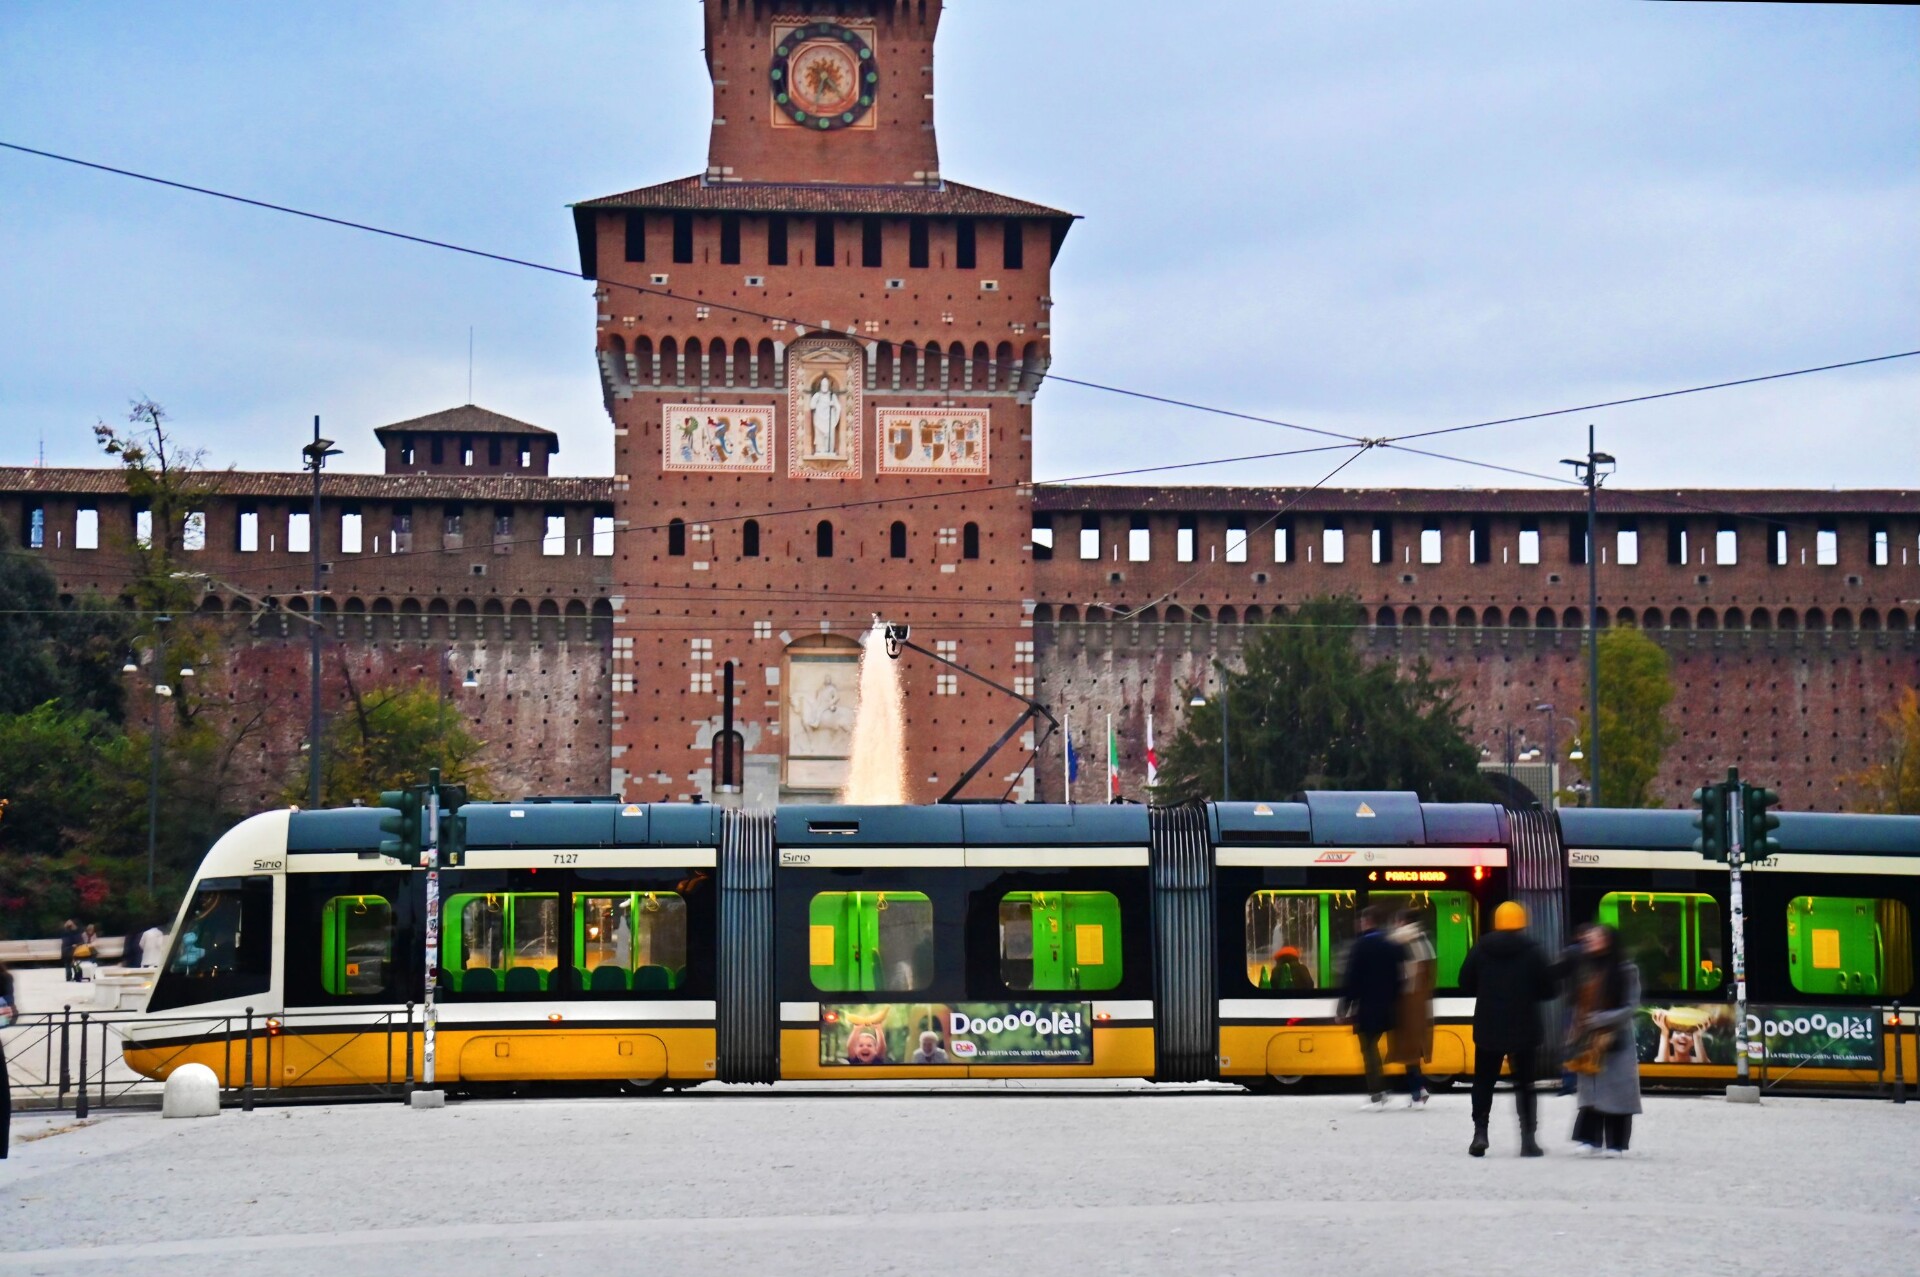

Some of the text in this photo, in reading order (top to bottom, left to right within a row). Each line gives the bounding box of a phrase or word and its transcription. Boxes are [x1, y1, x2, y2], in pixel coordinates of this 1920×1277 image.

[553, 854, 578, 864] 7127
[783, 852, 811, 862] Sirio
[1572, 852, 1600, 862] Sirio
[253, 859, 282, 869] Sirio
[1385, 871, 1418, 881] PARCO
[1420, 871, 1447, 881] NORD
[950, 1010, 1081, 1035] Dooooolè!
